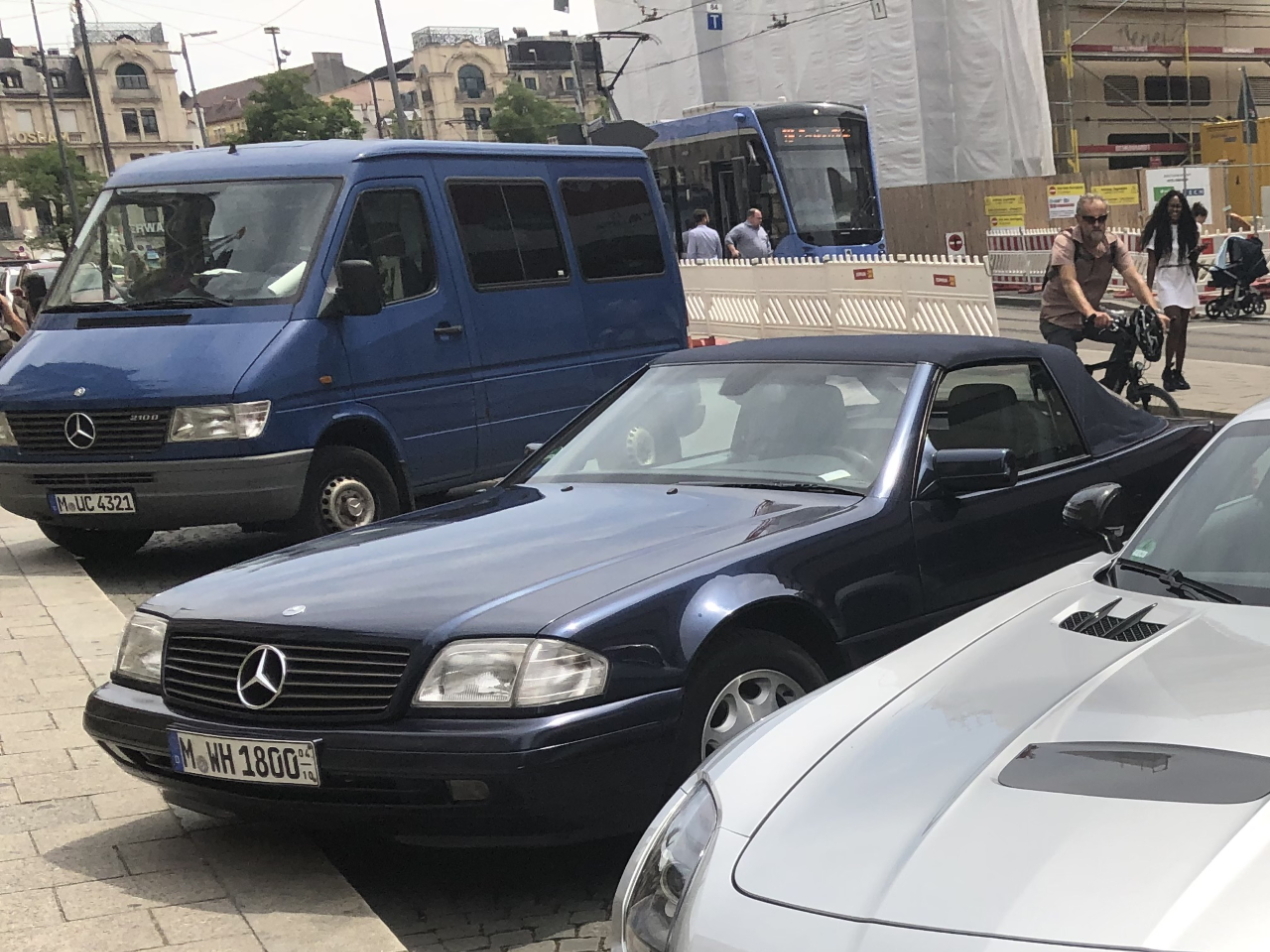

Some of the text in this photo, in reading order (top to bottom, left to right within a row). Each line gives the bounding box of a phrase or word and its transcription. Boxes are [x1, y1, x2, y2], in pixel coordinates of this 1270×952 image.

[57, 495, 134, 511] M UC 4321
[179, 736, 301, 779] M WH 1800
